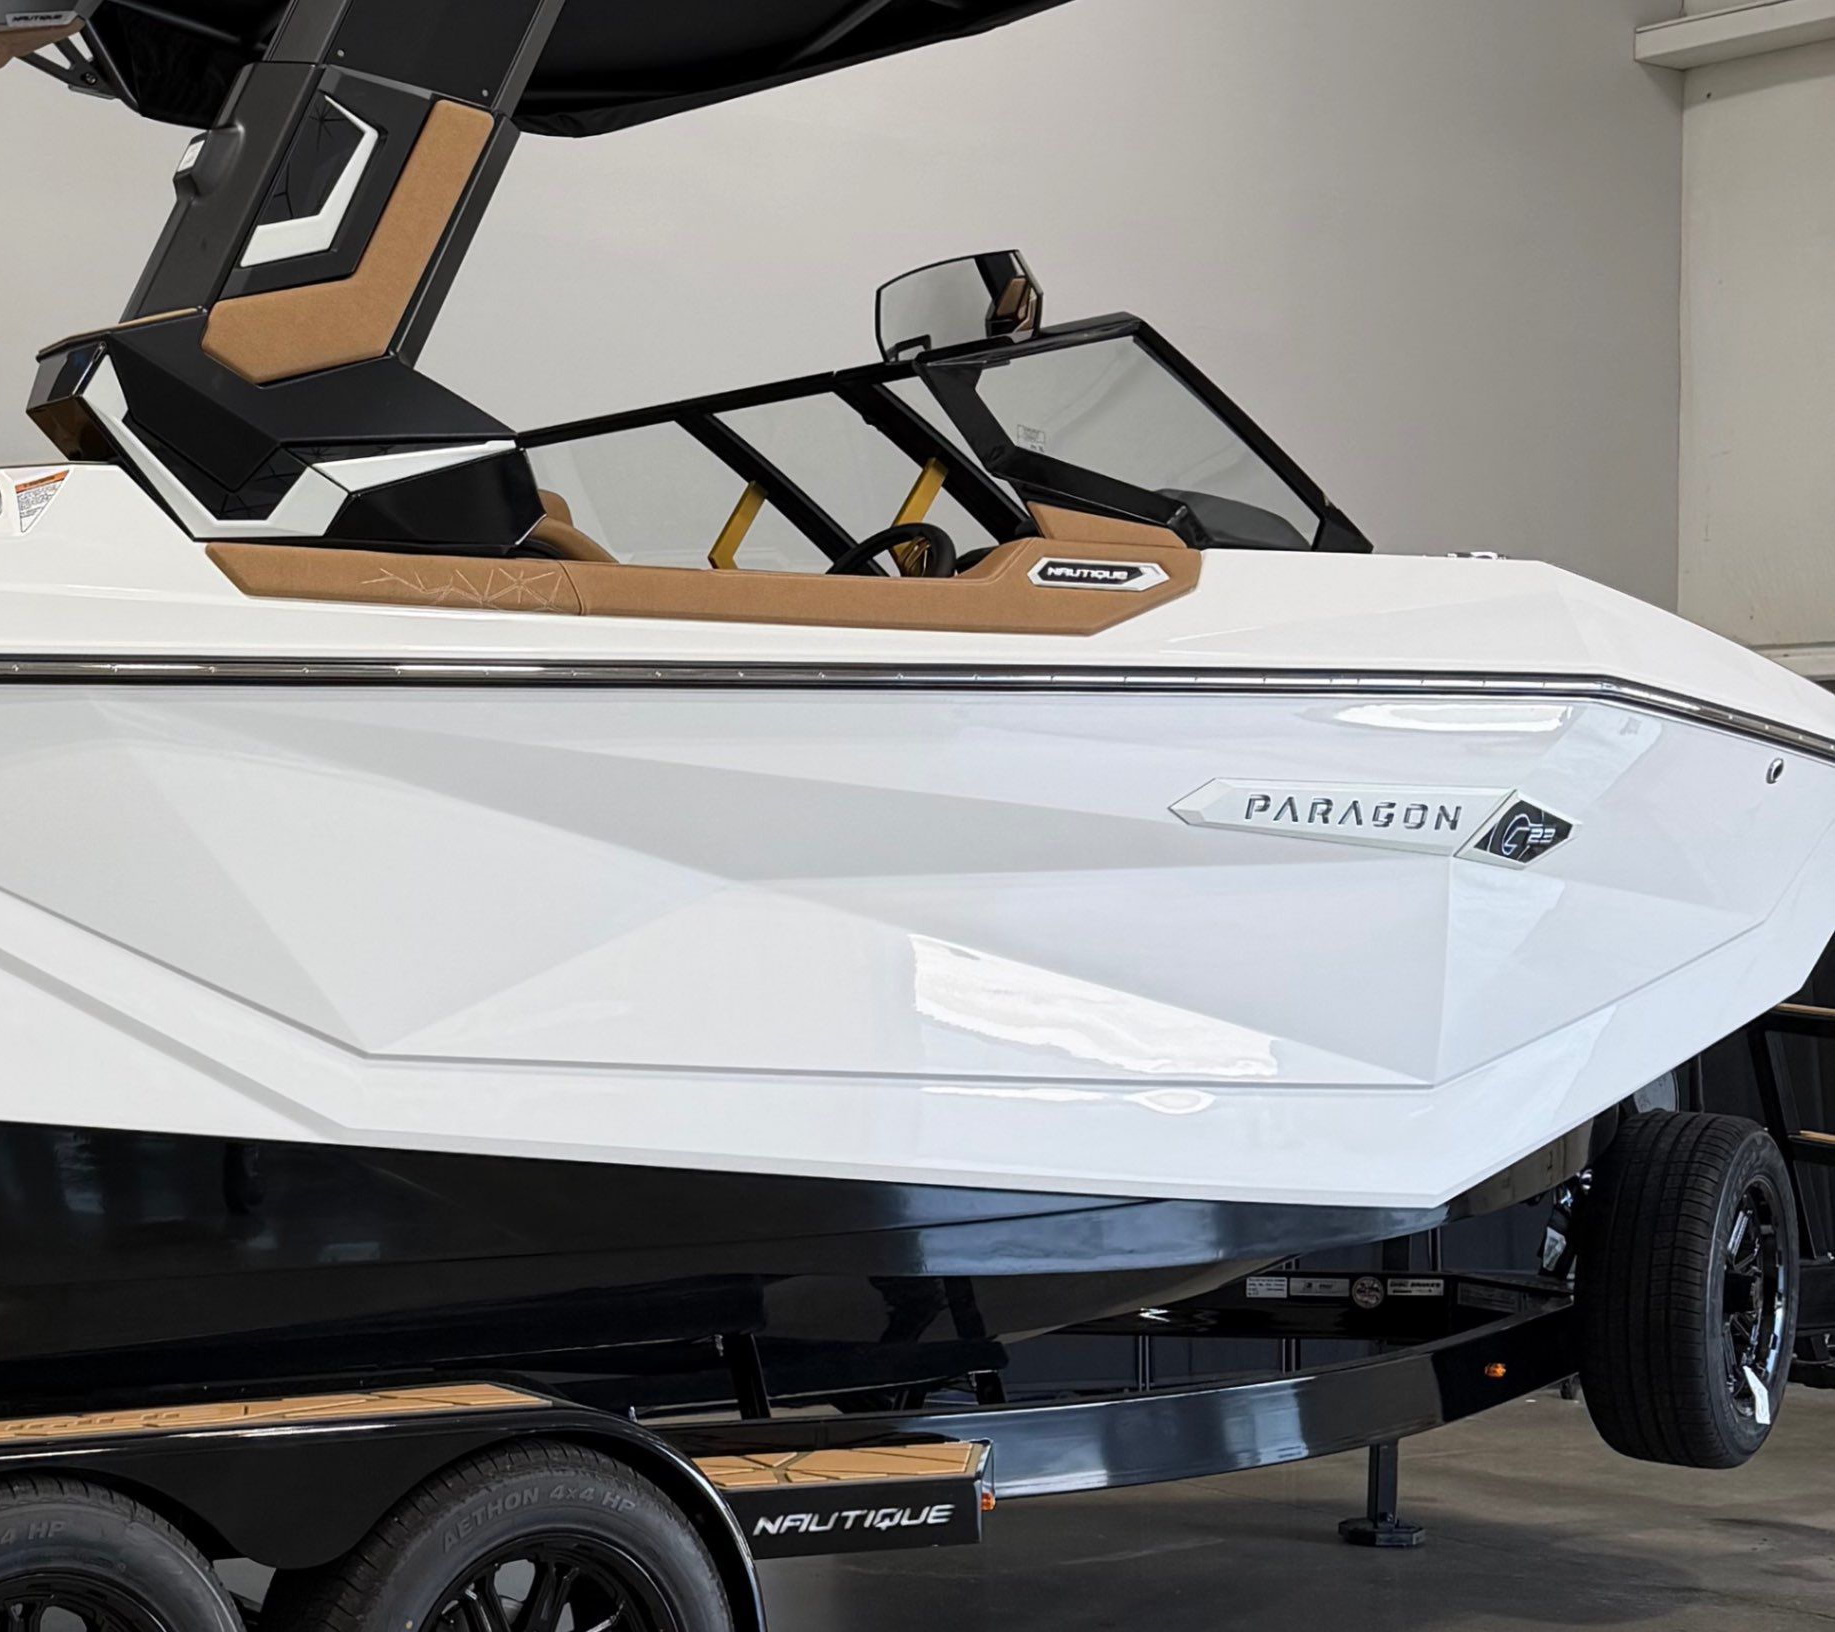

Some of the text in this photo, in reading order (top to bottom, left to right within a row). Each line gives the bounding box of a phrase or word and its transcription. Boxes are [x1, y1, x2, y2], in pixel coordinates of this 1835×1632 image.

[1047, 566, 1129, 581] NAUTIQUE
[1244, 793, 1463, 832] PARAGON
[27, 1520, 68, 1541] HP
[442, 1484, 638, 1554] AETHON 4x4 HP
[752, 1503, 956, 1537] NAUTIQUE
